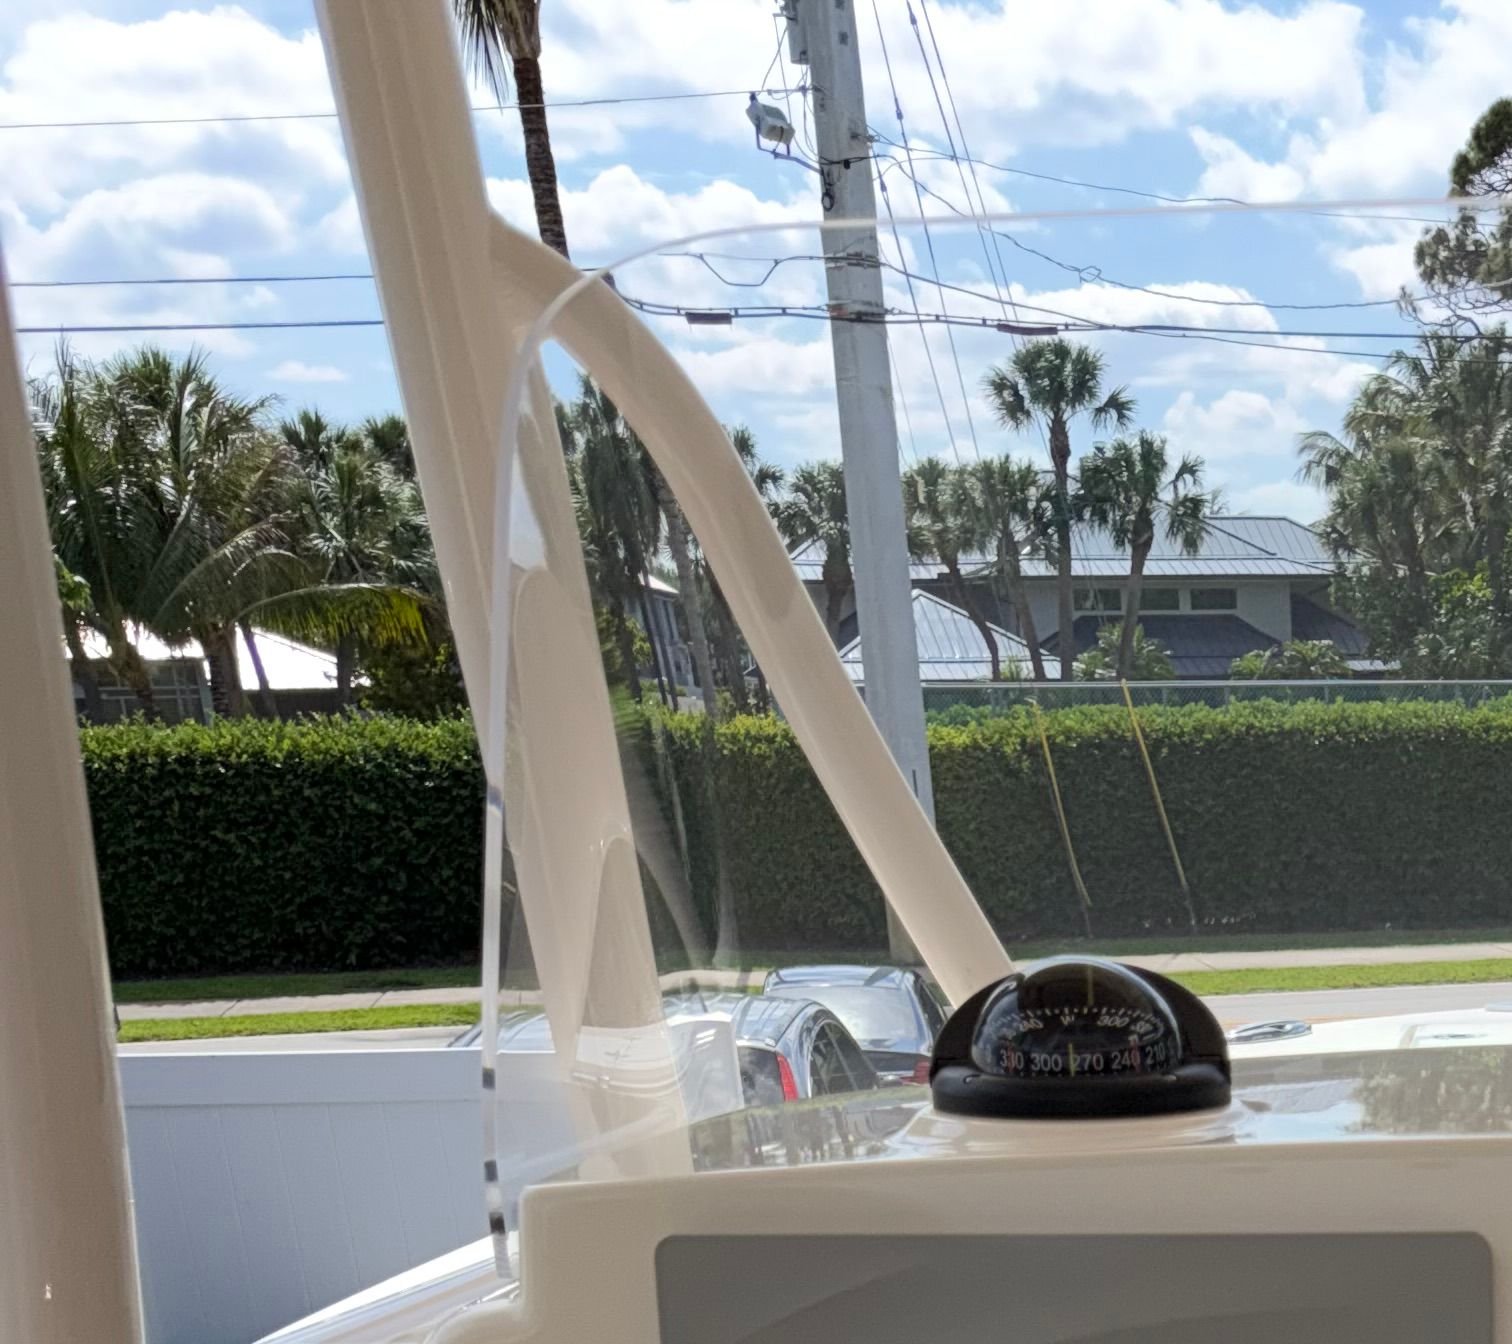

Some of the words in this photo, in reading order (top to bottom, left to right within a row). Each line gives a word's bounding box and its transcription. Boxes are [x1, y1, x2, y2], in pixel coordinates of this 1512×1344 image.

[1031, 1052, 1063, 1072] 300
[1072, 1053, 1105, 1072] 270
[1111, 1051, 1140, 1070] 240
[1145, 1041, 1166, 1065] 210
